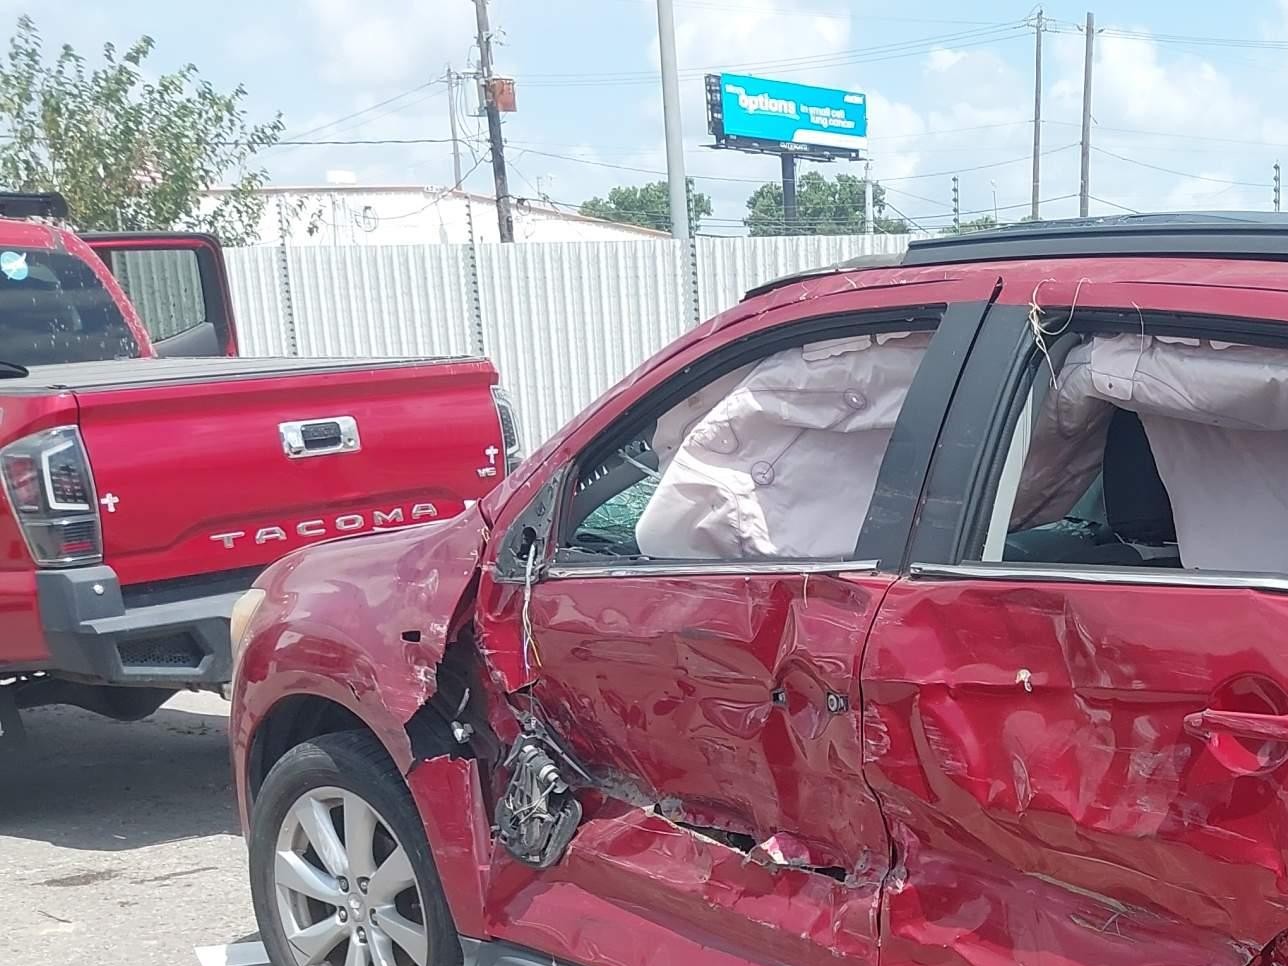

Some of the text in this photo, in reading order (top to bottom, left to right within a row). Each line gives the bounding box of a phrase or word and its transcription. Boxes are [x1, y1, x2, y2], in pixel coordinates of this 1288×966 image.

[738, 92, 797, 115] options
[808, 106, 830, 117] small
[831, 109, 845, 118] cell
[810, 115, 856, 128] lung cancer
[210, 503, 438, 549] TACOMA
